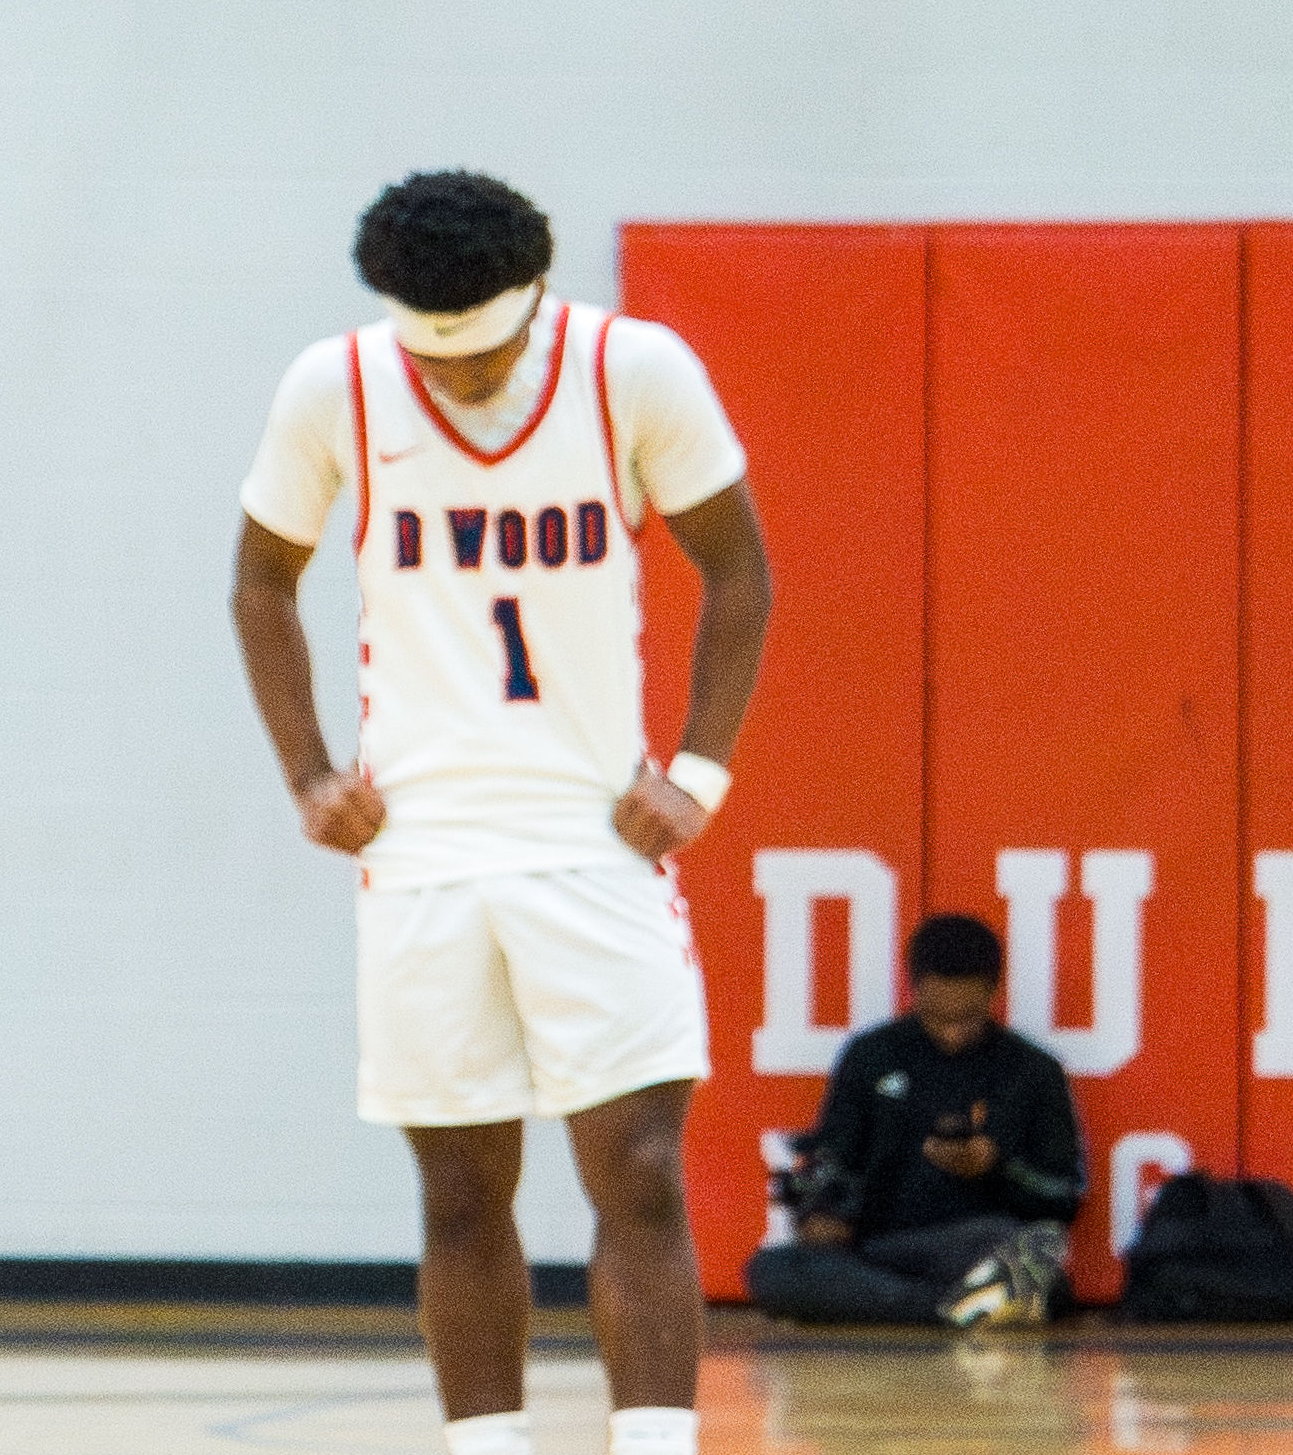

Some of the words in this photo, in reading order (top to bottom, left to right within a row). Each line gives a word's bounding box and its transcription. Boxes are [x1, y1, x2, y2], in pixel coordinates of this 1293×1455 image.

[393, 509, 423, 570] D
[444, 499, 609, 571] WOOD
[491, 595, 540, 703] 1
